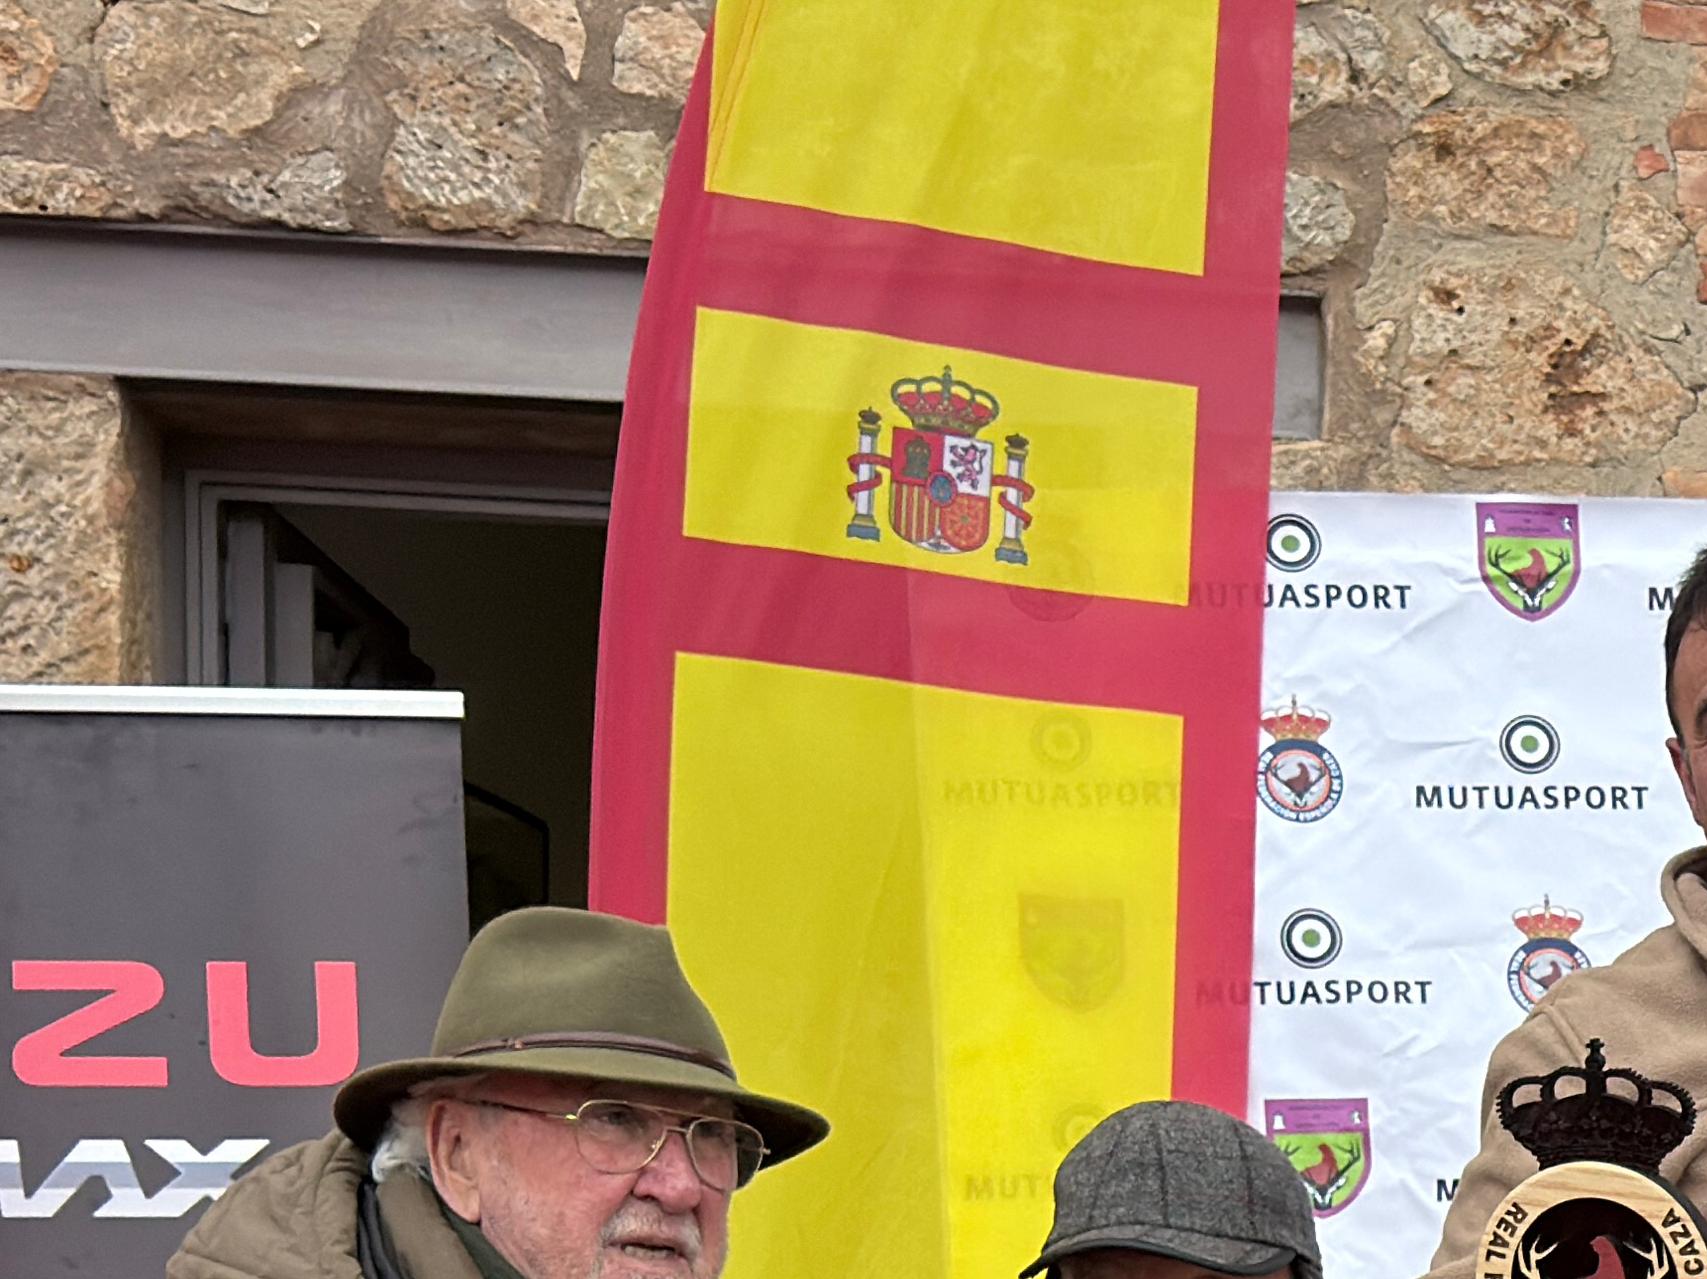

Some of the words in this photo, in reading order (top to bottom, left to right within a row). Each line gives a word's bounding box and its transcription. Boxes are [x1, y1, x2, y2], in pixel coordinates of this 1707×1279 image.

[1415, 784, 1649, 811] MUTUASPORT
[1486, 1201, 1529, 1268] REAL
[1661, 1208, 1707, 1276] CAZA
